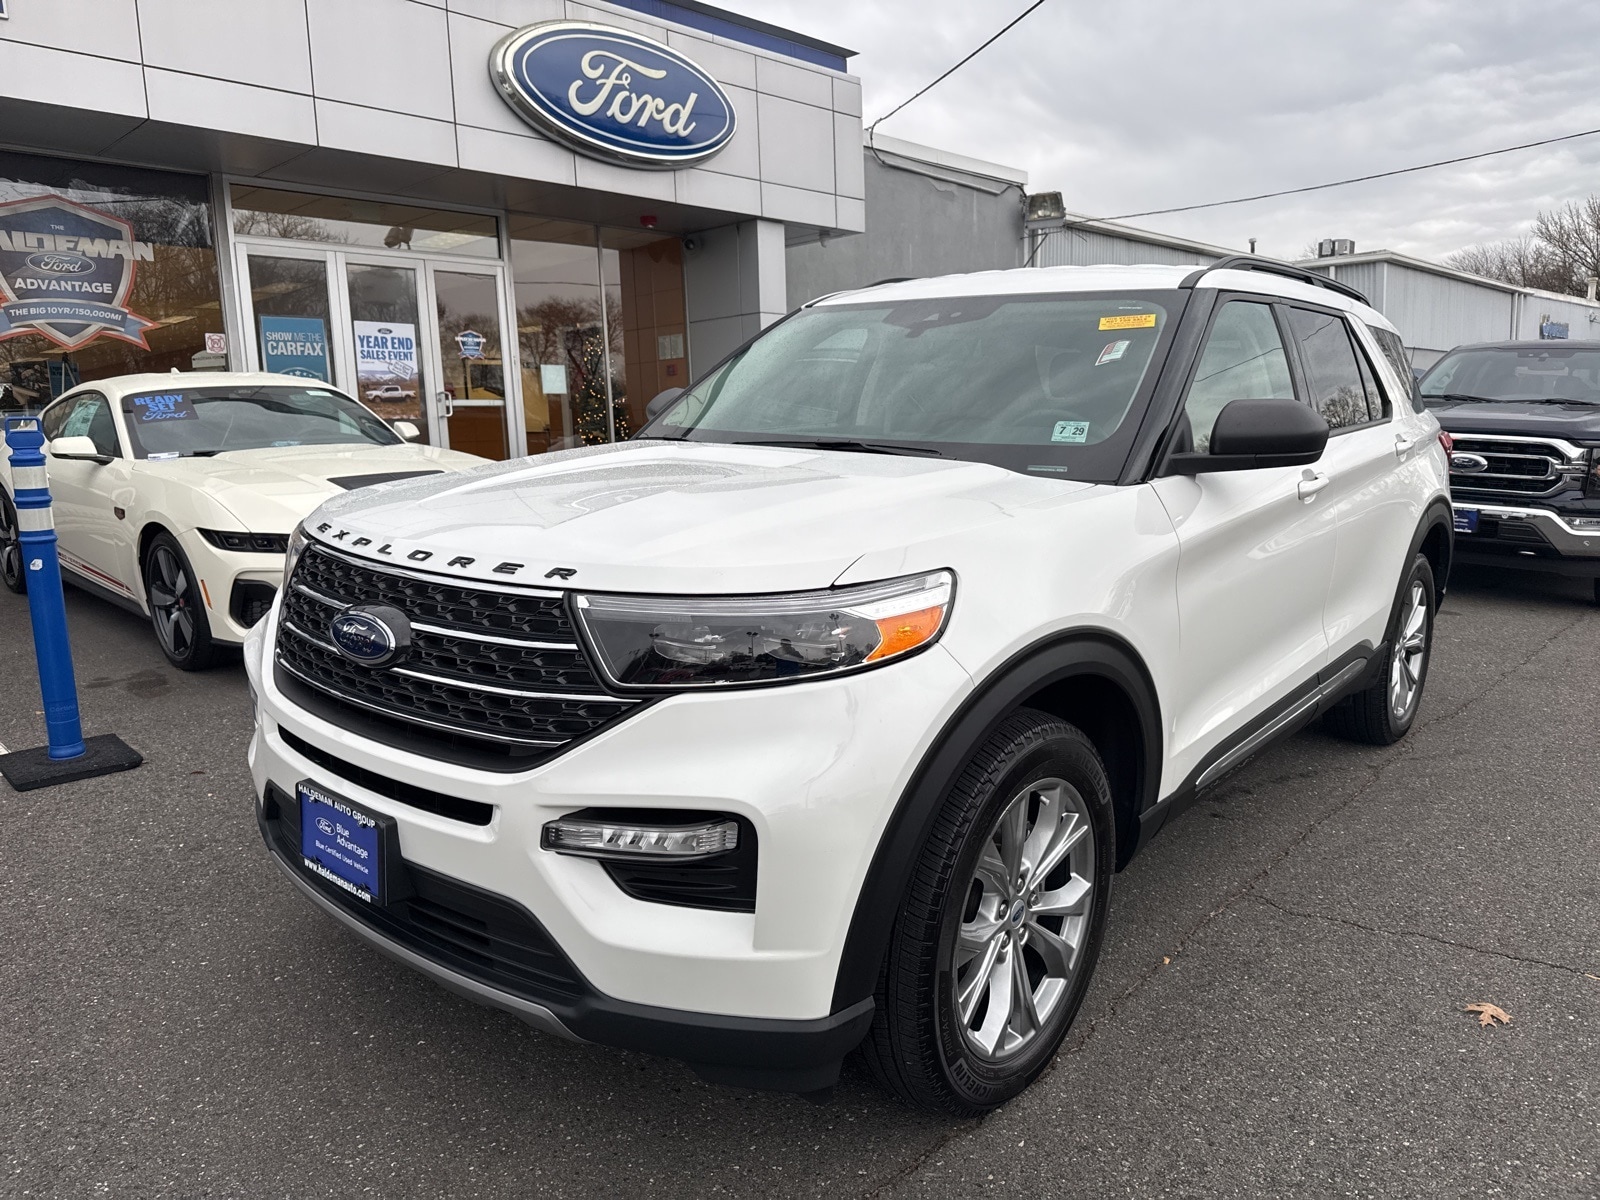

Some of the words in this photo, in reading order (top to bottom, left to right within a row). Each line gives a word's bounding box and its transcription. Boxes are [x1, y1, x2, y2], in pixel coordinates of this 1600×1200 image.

[568, 50, 698, 138] Ford
[40, 254, 82, 272] Ford
[14, 277, 113, 294] ADVANTAGE
[9, 308, 29, 317] THE
[29, 307, 47, 315] BIG
[265, 331, 292, 341] SHOW
[294, 332, 306, 342] ME
[307, 332, 322, 342] THE
[357, 334, 389, 350] YEAR
[390, 336, 413, 351] END
[267, 341, 323, 356] CARFAX
[360, 349, 387, 361] SALES
[387, 350, 413, 362] EVENT
[134, 394, 183, 406] READY
[147, 401, 176, 412] SET
[142, 409, 188, 421] Ford
[1059, 426, 1068, 435] 7
[1071, 426, 1085, 436] 29
[316, 522, 577, 580] EXPLORER
[298, 783, 334, 807] HALDEMAN
[334, 799, 352, 816] AUTO
[352, 810, 376, 828] GROUP
[336, 823, 350, 838] Blue
[315, 839, 325, 850] Blue
[336, 834, 369, 859] Advantage
[304, 857, 371, 903] www.haldemanauto.com
[940, 1006, 954, 1057] PRIMACY
[954, 1062, 1002, 1098] MICHELIN
